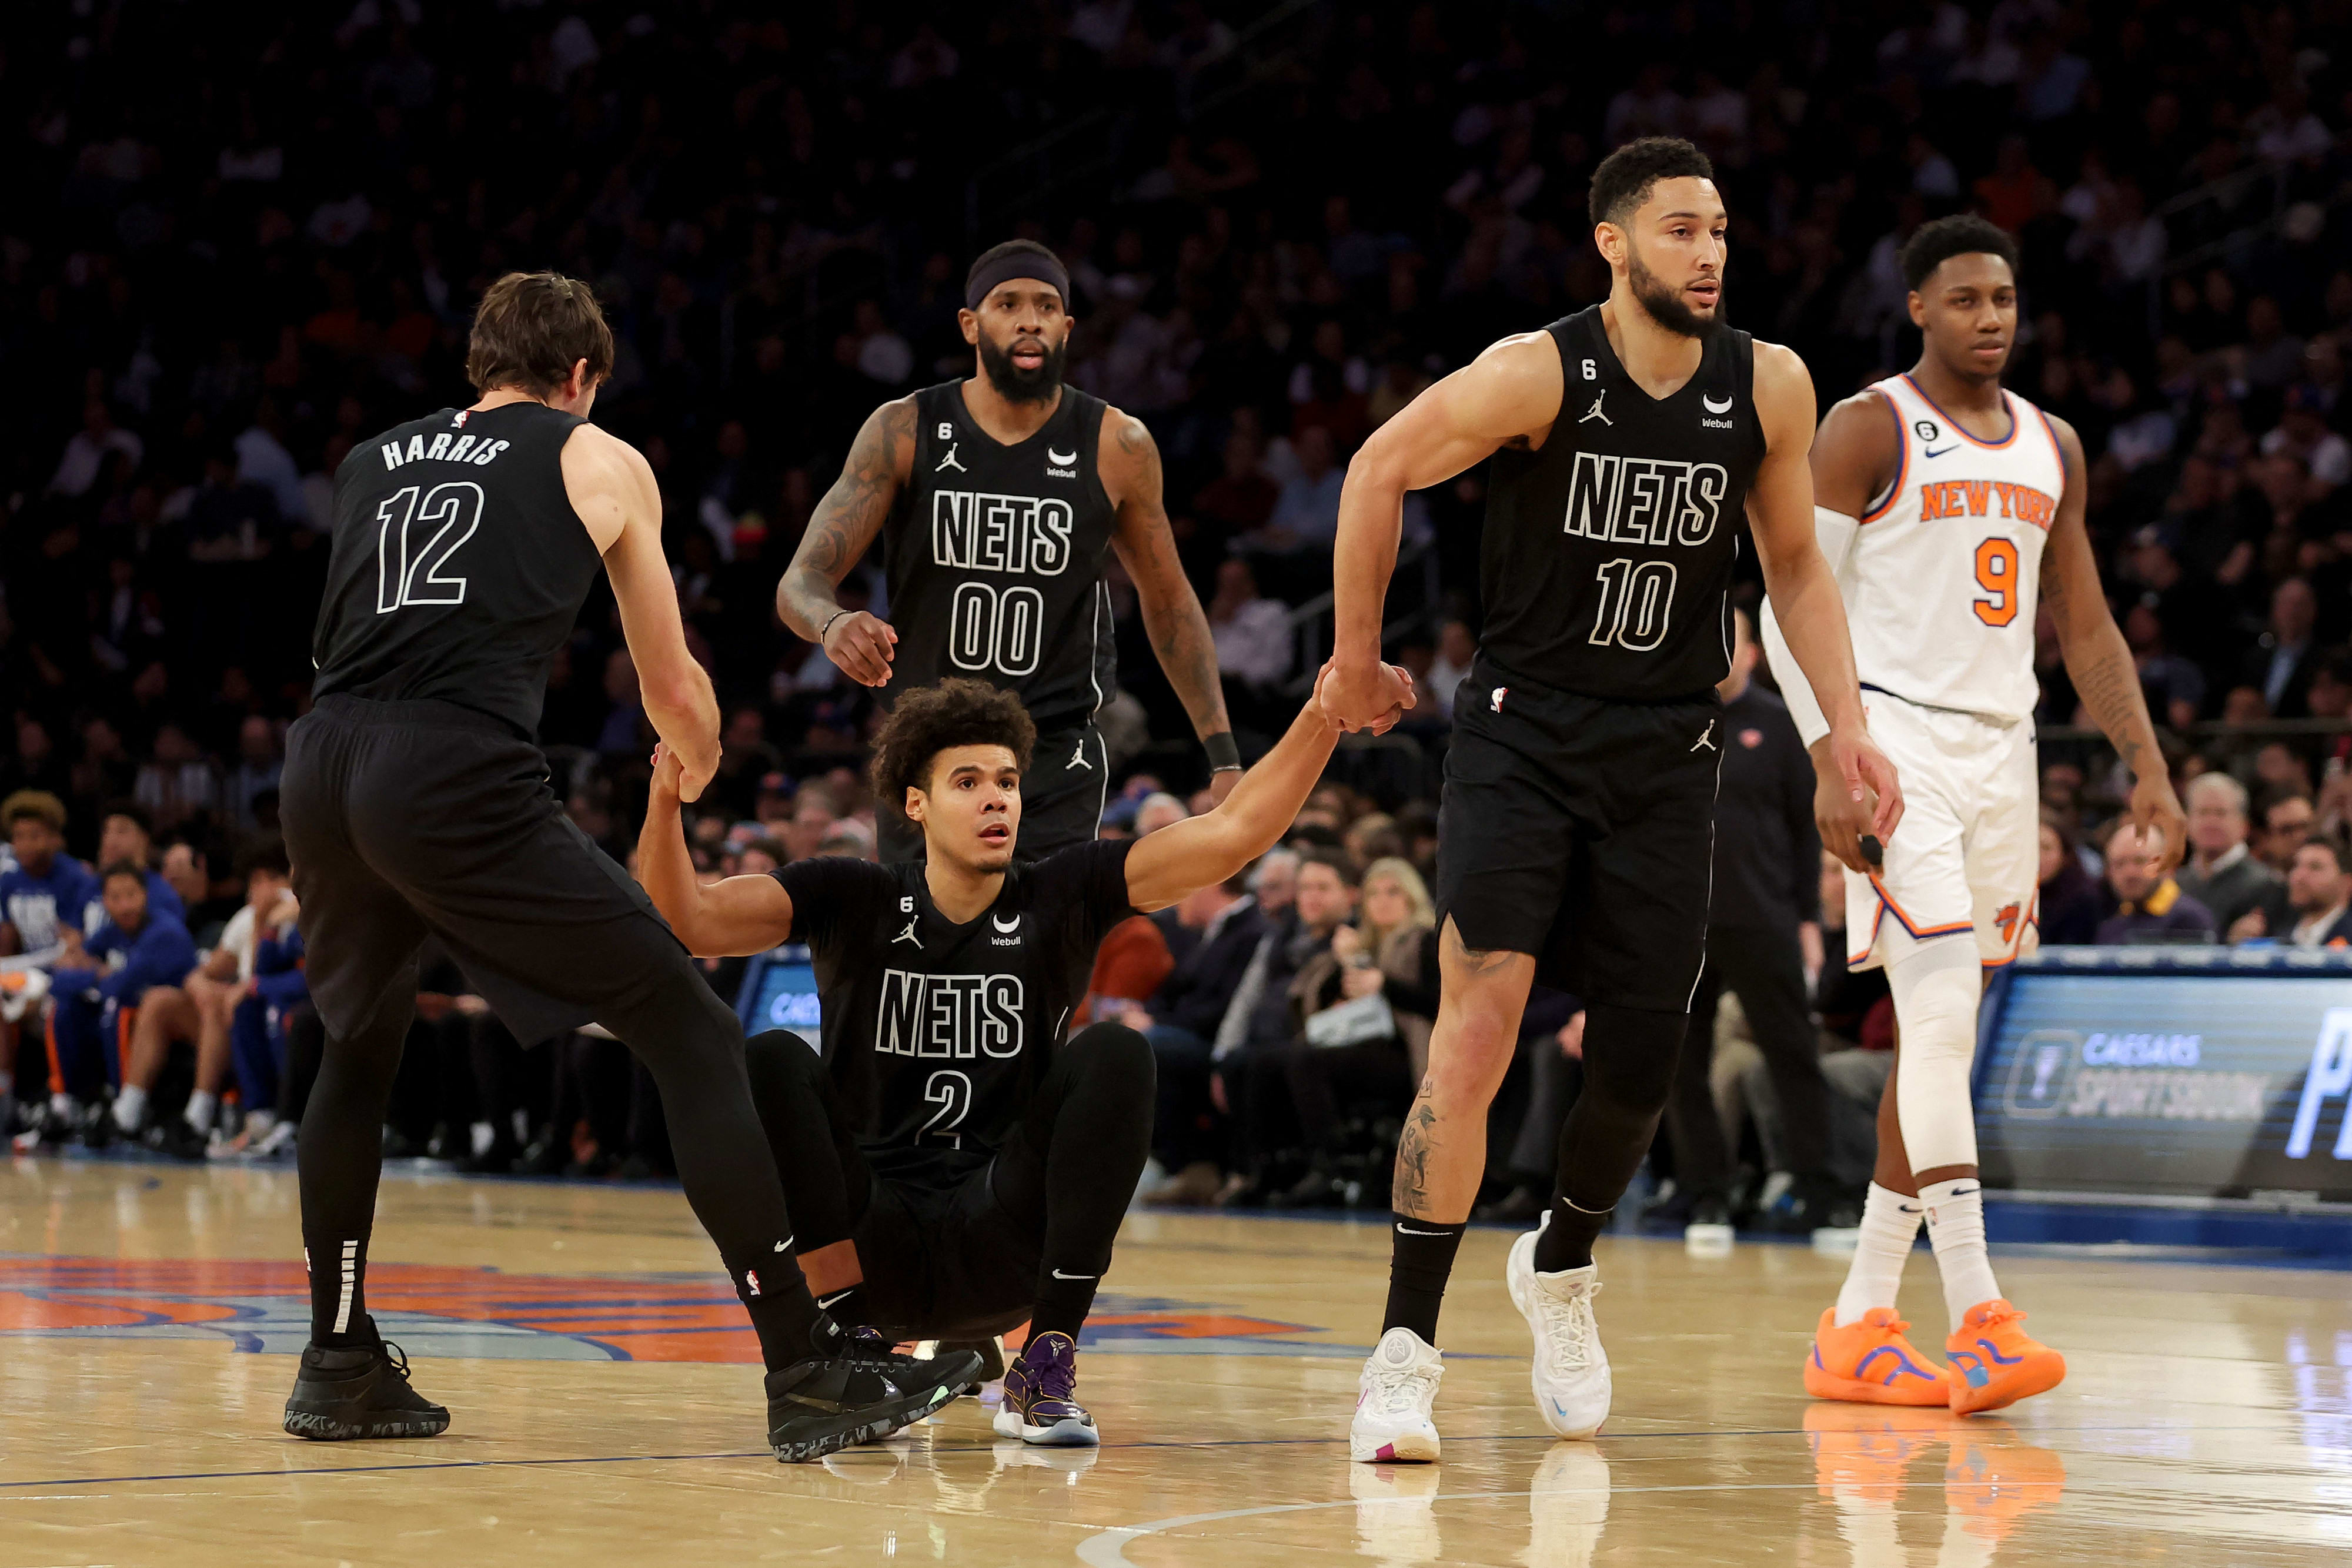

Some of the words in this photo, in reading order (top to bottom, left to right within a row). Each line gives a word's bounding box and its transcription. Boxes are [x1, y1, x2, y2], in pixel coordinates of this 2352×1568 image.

[1581, 359, 1597, 380] 6
[380, 432, 511, 472] HARRIS
[937, 422, 953, 440] 6
[1702, 418, 1733, 429] Webull
[1047, 467, 1077, 479] Webull
[1563, 451, 1728, 546] NETS
[1920, 480, 1992, 523] NEW
[1994, 481, 2055, 532] YORK
[376, 481, 485, 614] 12
[932, 489, 1074, 577] NETS
[1588, 558, 1678, 652] 10
[1973, 536, 2019, 627] 9
[949, 581, 1044, 677] 00
[900, 896, 914, 913] 6
[991, 936, 1021, 947] Webull
[875, 968, 1024, 1059] NETS
[914, 1069, 972, 1151] 2
[2284, 1006, 2352, 1160] P
